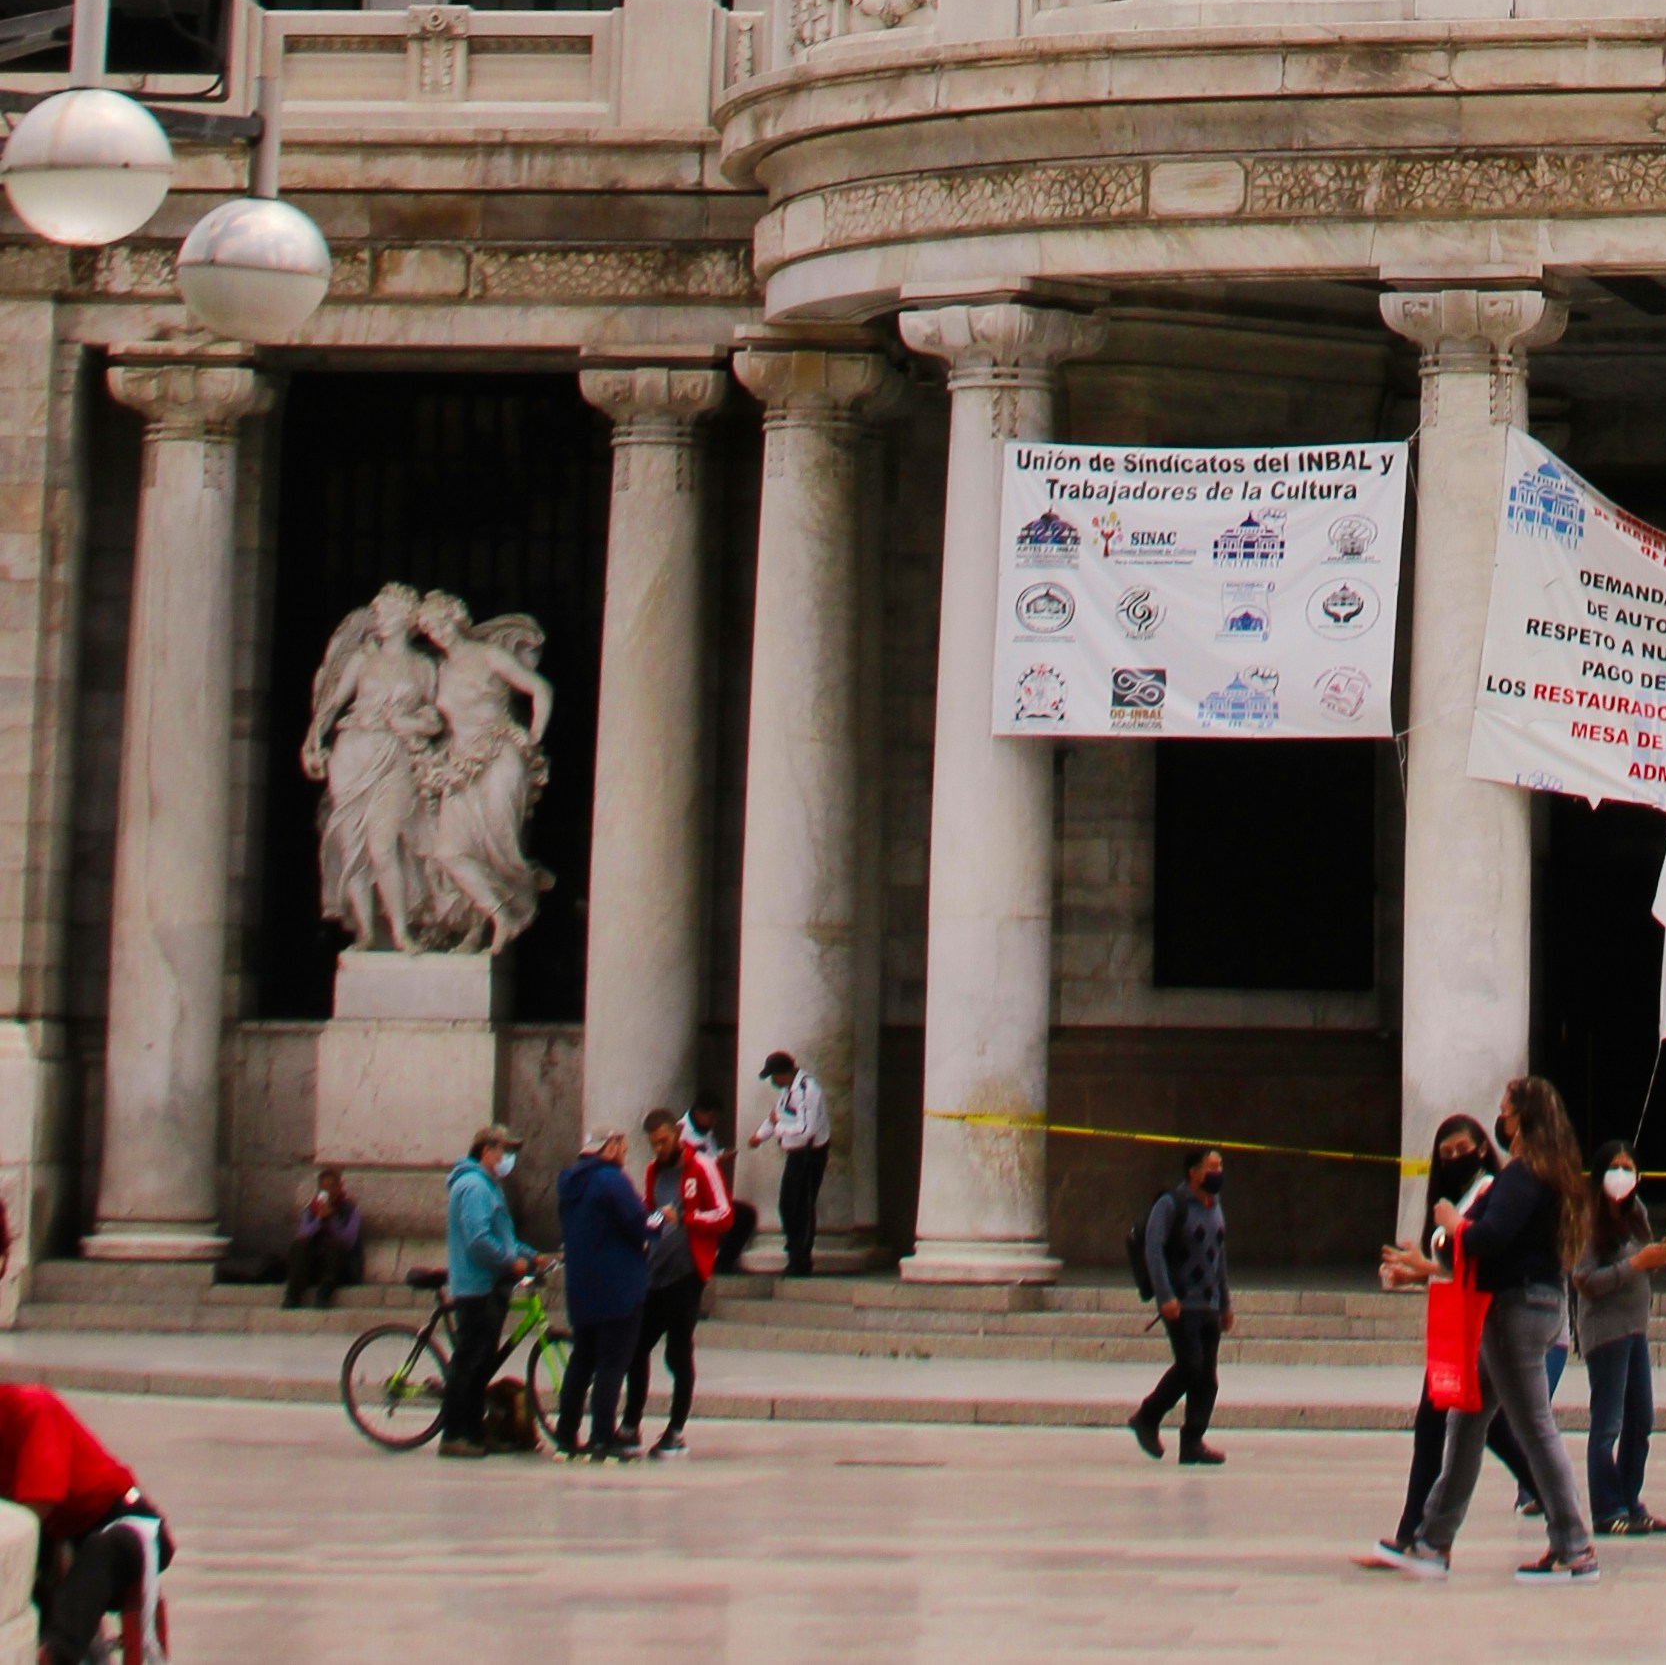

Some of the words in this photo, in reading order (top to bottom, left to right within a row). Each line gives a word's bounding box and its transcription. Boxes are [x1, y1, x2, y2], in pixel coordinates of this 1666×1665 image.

[1016, 449, 1081, 471] Unión
[1089, 452, 1115, 472] de
[1253, 453, 1289, 473] del
[1298, 450, 1372, 472] INBAL
[1380, 453, 1395, 475] y
[1046, 478, 1198, 505] Trabajadores
[1206, 480, 1234, 501] de
[1241, 480, 1262, 501] la
[1271, 480, 1358, 501] Cultura
[1130, 530, 1177, 546] SINAC
[1587, 599, 1609, 621] DE
[1525, 617, 1616, 651] RESPETO
[1621, 639, 1635, 656] A
[1485, 674, 1527, 697] LOS
[1581, 660, 1634, 684] PAGO
[1640, 673, 1666, 691] DE
[1570, 720, 1630, 746] MESA
[1637, 730, 1664, 751] DE
